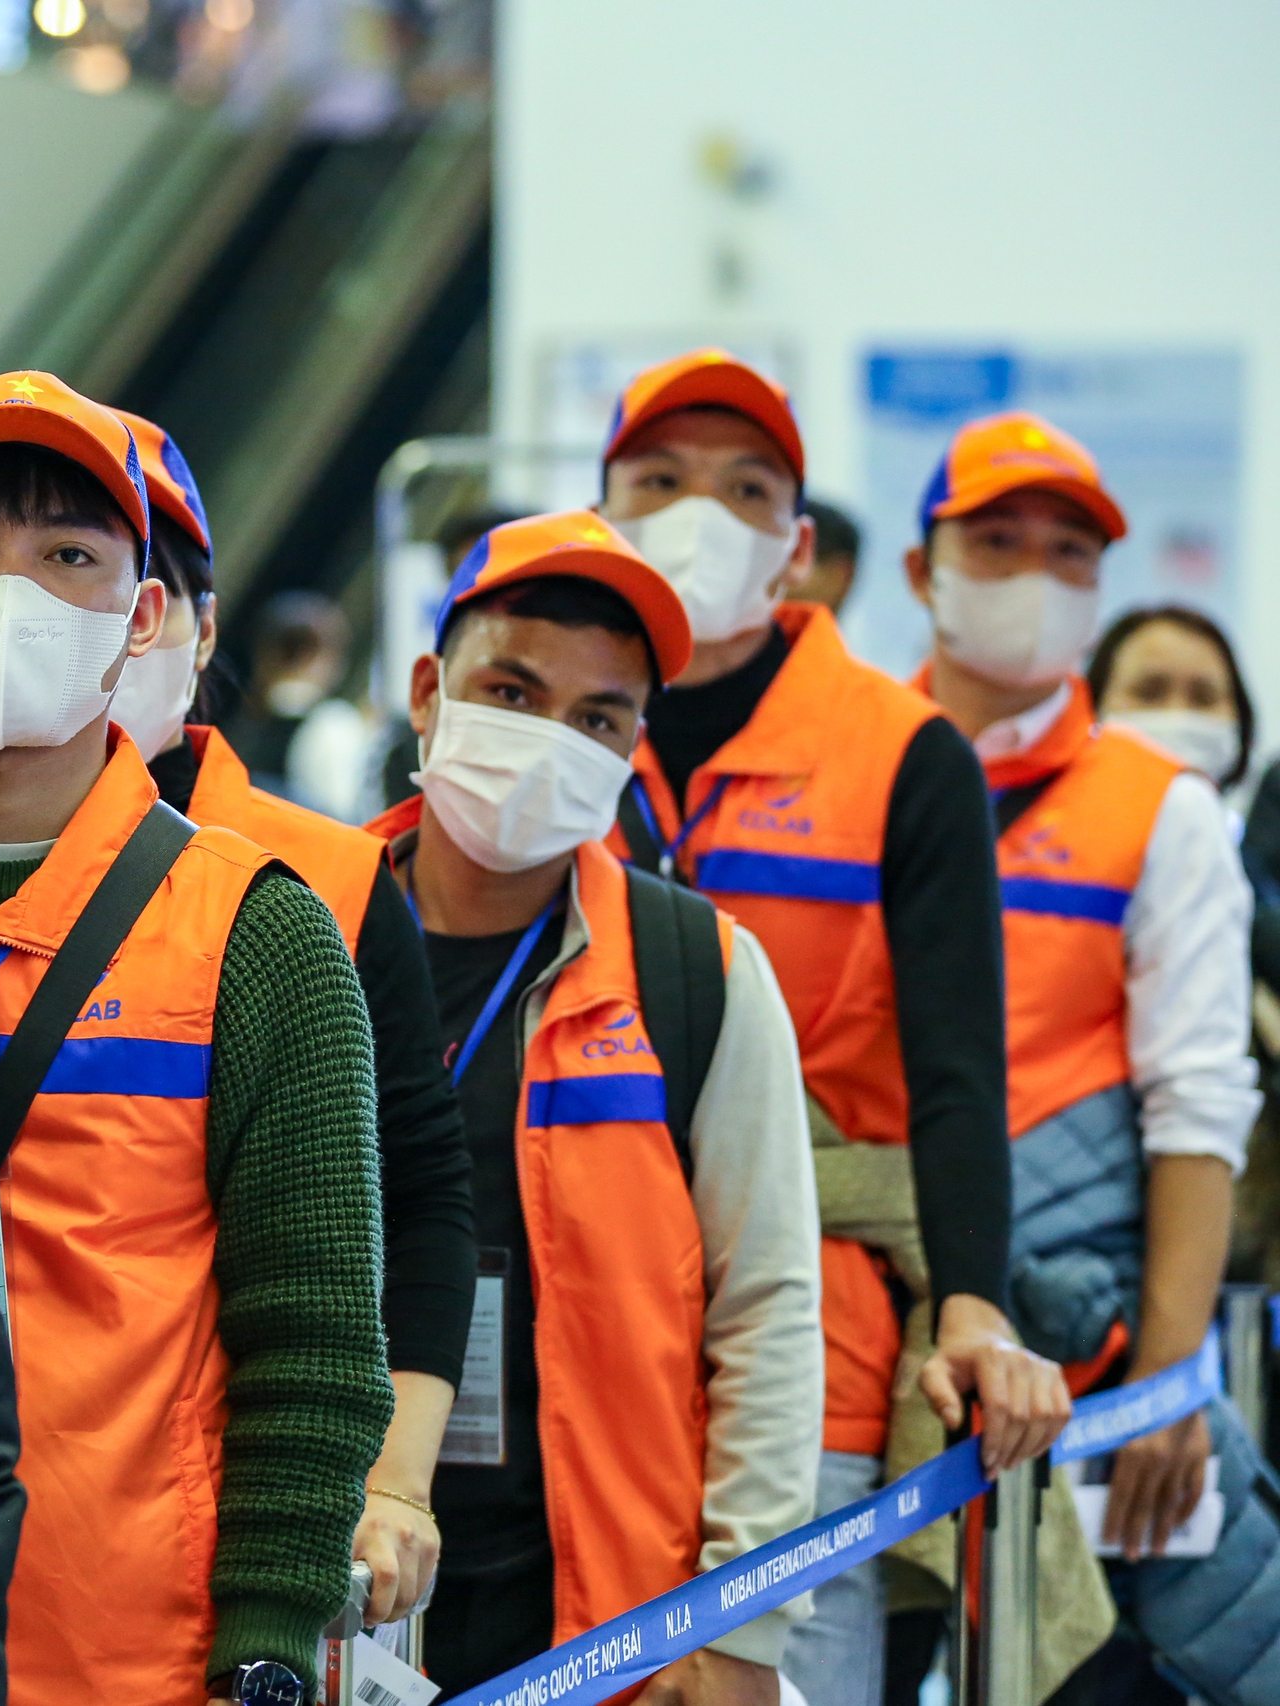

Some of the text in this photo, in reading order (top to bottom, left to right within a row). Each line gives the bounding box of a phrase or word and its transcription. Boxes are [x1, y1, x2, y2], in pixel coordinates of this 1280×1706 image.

[582, 1036, 655, 1059] COLA
[756, 1530, 835, 1592] INTERNATIONAL
[833, 1508, 877, 1549] AIRPORT
[550, 1654, 583, 1700] QUỐC
[585, 1641, 600, 1680] TẾ
[601, 1636, 621, 1675] NỘI
